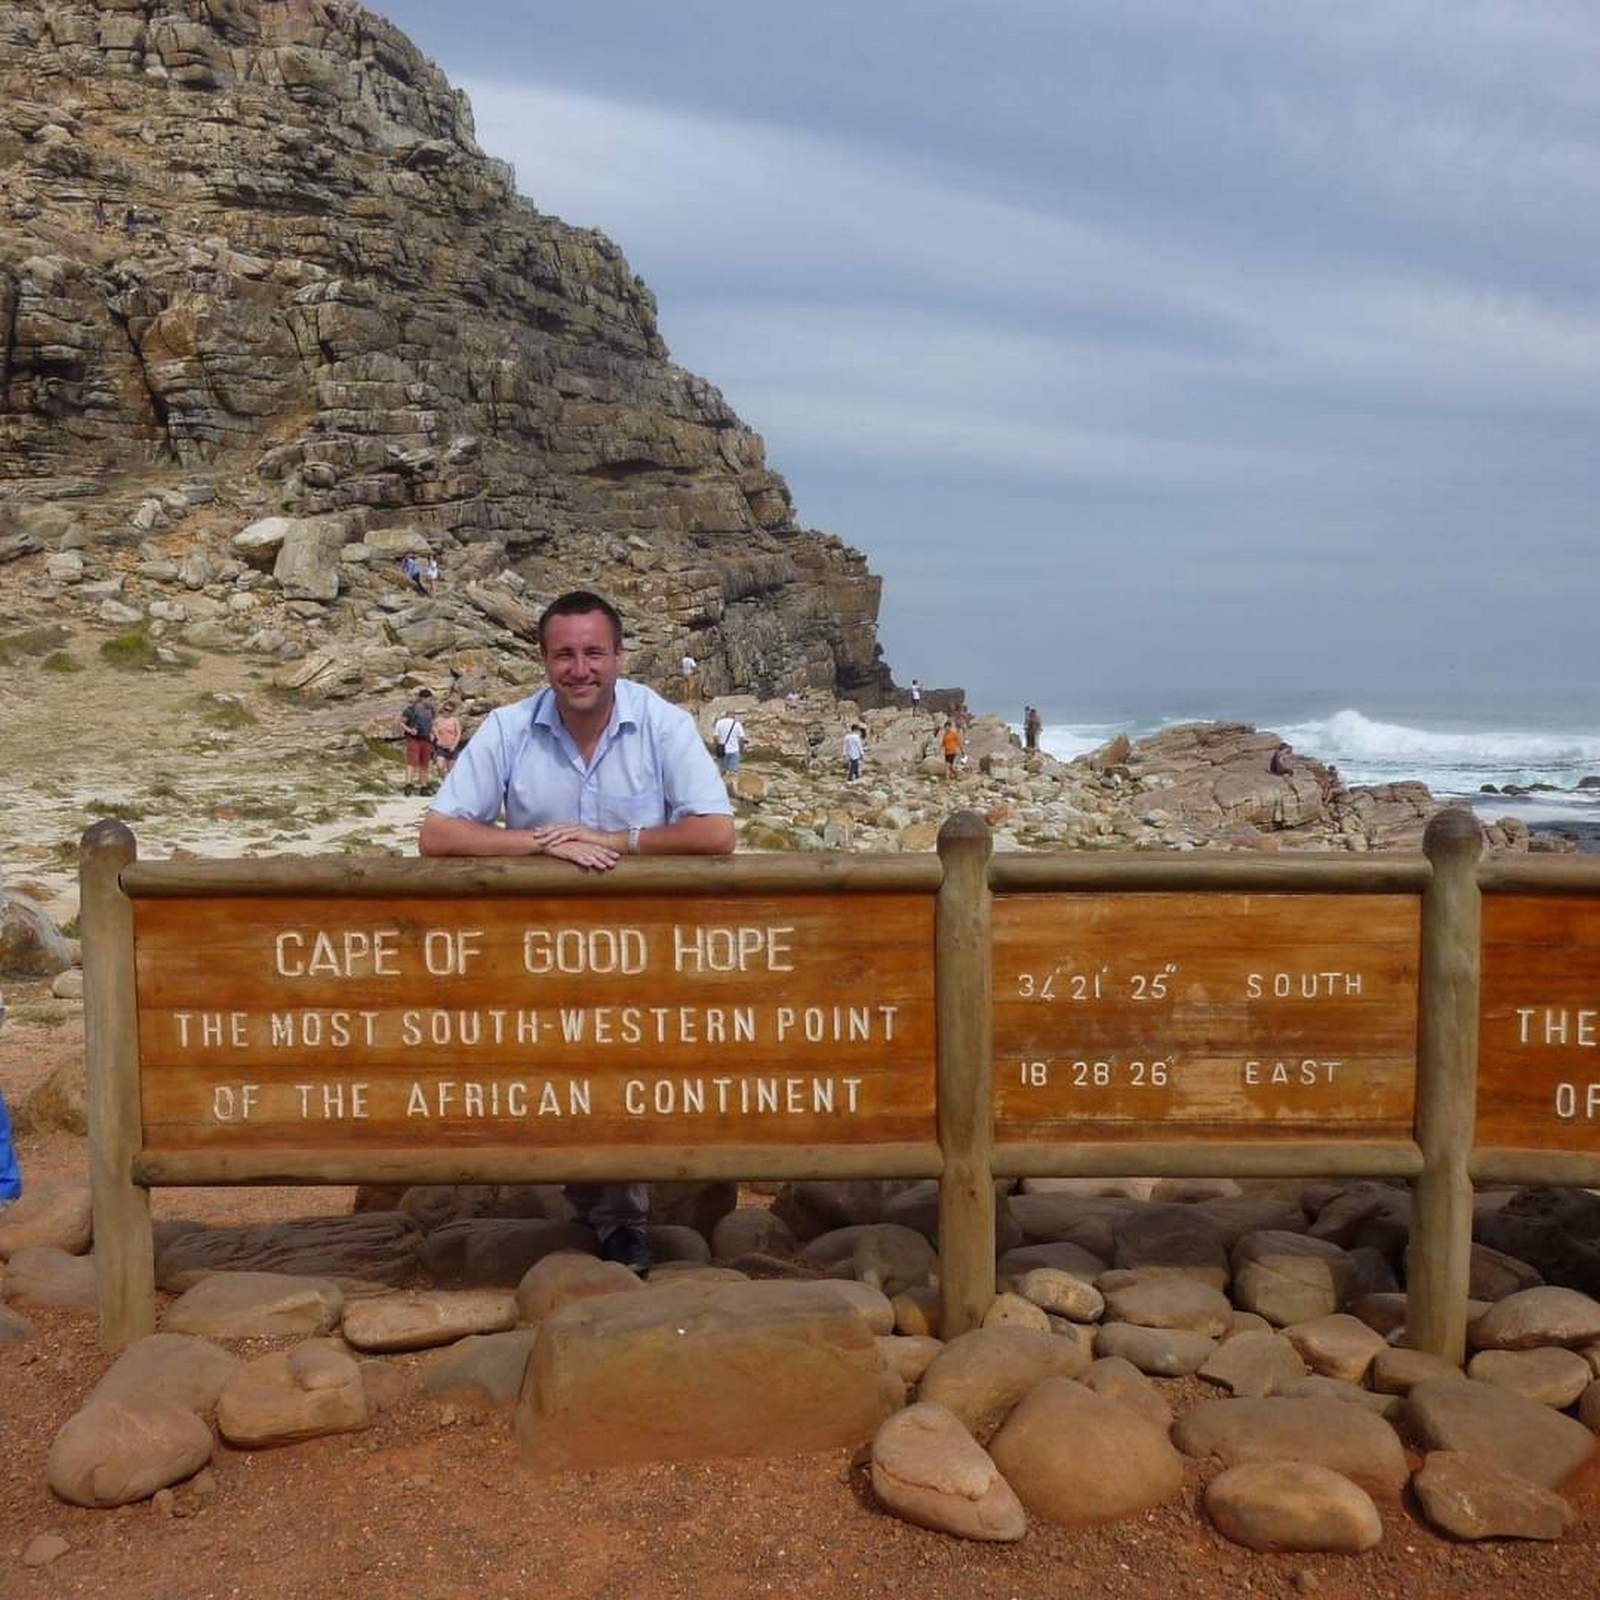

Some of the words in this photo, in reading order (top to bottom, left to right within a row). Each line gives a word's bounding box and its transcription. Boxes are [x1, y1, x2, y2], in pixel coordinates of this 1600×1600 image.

[276, 930, 401, 977] CAPE
[425, 930, 485, 975] OF
[523, 929, 648, 974] GOOD
[674, 925, 796, 973] HOPE
[1246, 972, 1363, 999] SOUTH
[174, 1012, 249, 1048] THE
[272, 1011, 379, 1048] MOST
[402, 1007, 756, 1046] SOUTH-WESTERN
[777, 1006, 899, 1043] POINT
[1516, 1008, 1598, 1046] THE
[1246, 1060, 1343, 1086] EAST
[214, 1084, 260, 1121] OF
[295, 1083, 370, 1119] THE
[406, 1080, 593, 1119] AFRICAN
[625, 1077, 863, 1116] CONTINENT
[1555, 1083, 1600, 1118] OF
